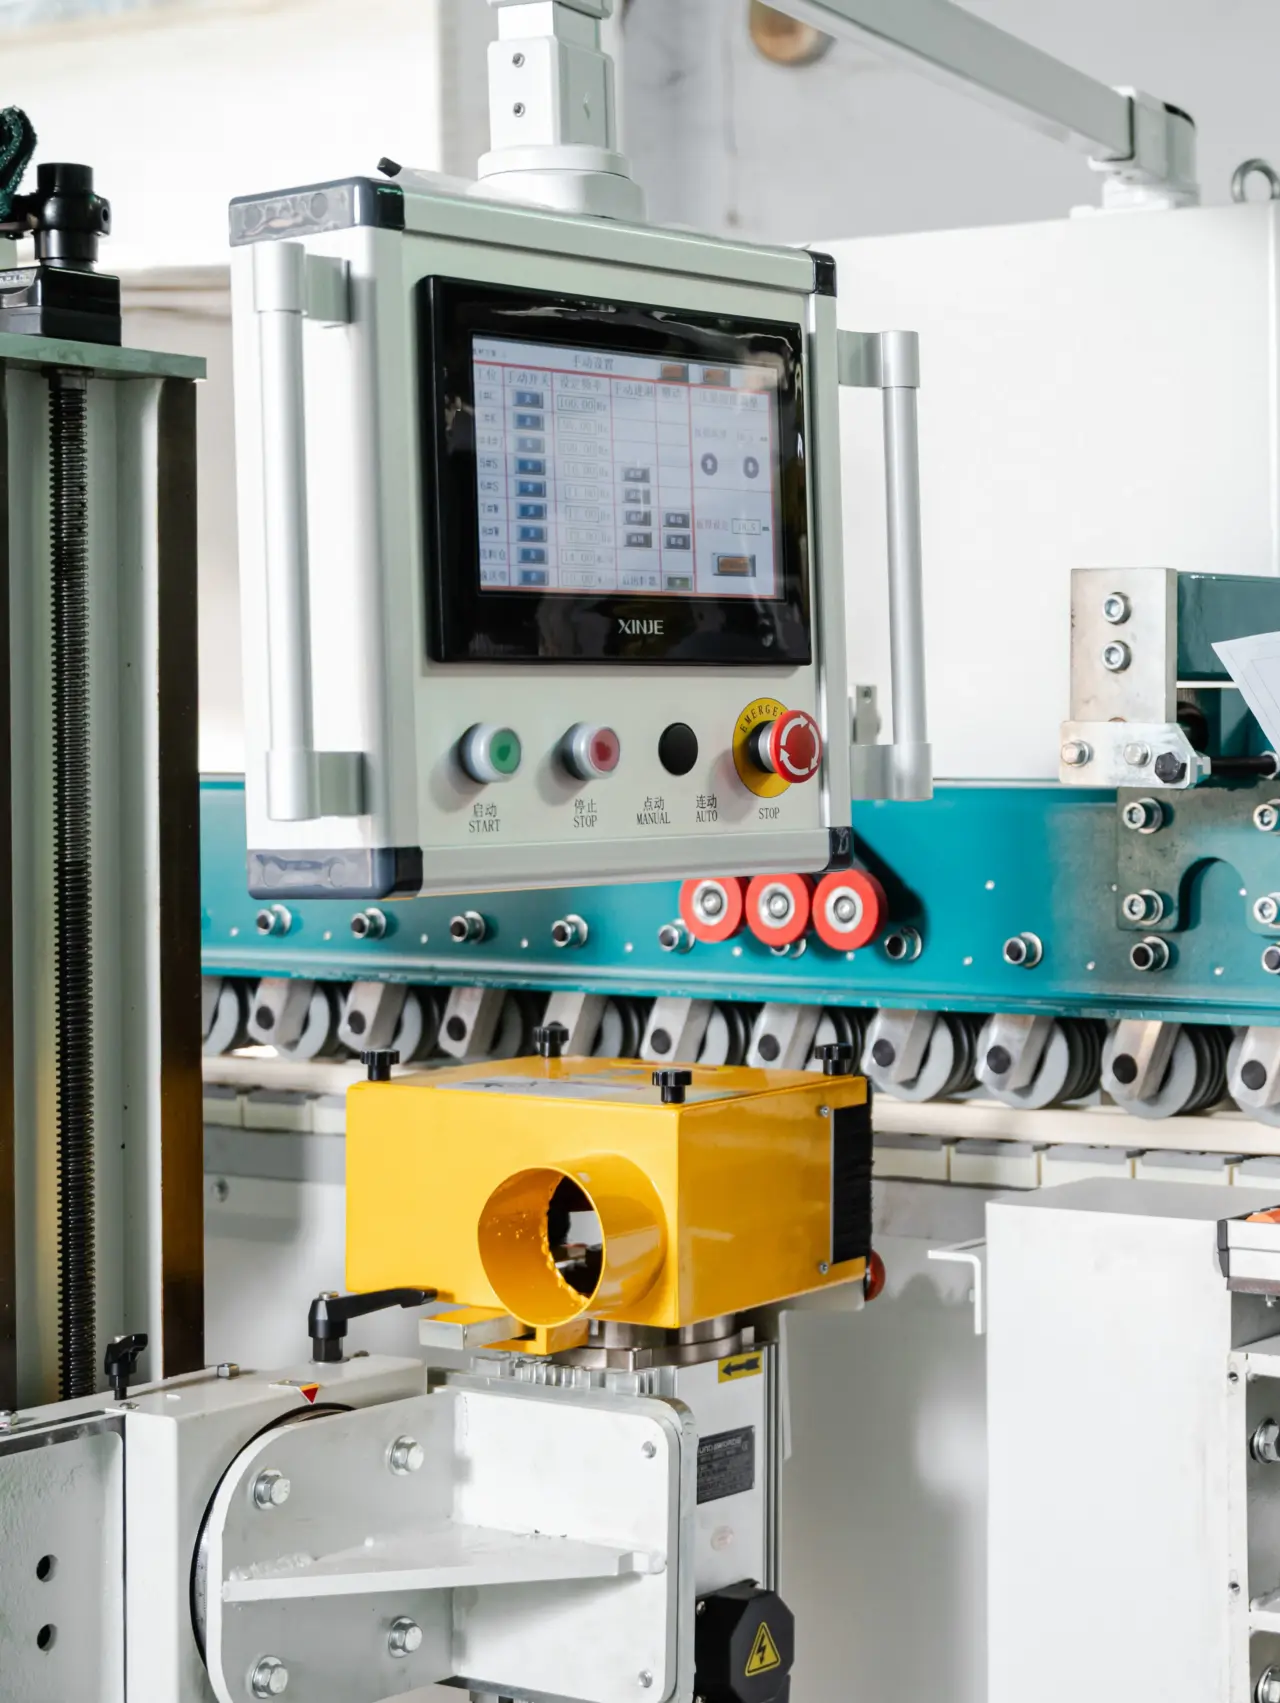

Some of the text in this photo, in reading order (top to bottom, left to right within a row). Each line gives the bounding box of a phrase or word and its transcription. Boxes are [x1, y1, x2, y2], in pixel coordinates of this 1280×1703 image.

[618, 618, 665, 635] XINJE
[740, 704, 782, 733] EMERGE
[574, 799, 597, 814] 停止
[643, 796, 665, 811] 点动
[696, 793, 717, 809] 连动
[473, 803, 498, 818] 启动
[696, 809, 718, 823] AUTO
[759, 807, 780, 820] STOP
[469, 819, 501, 833] START
[573, 815, 598, 828] STOP
[636, 812, 670, 825] MANUAL
